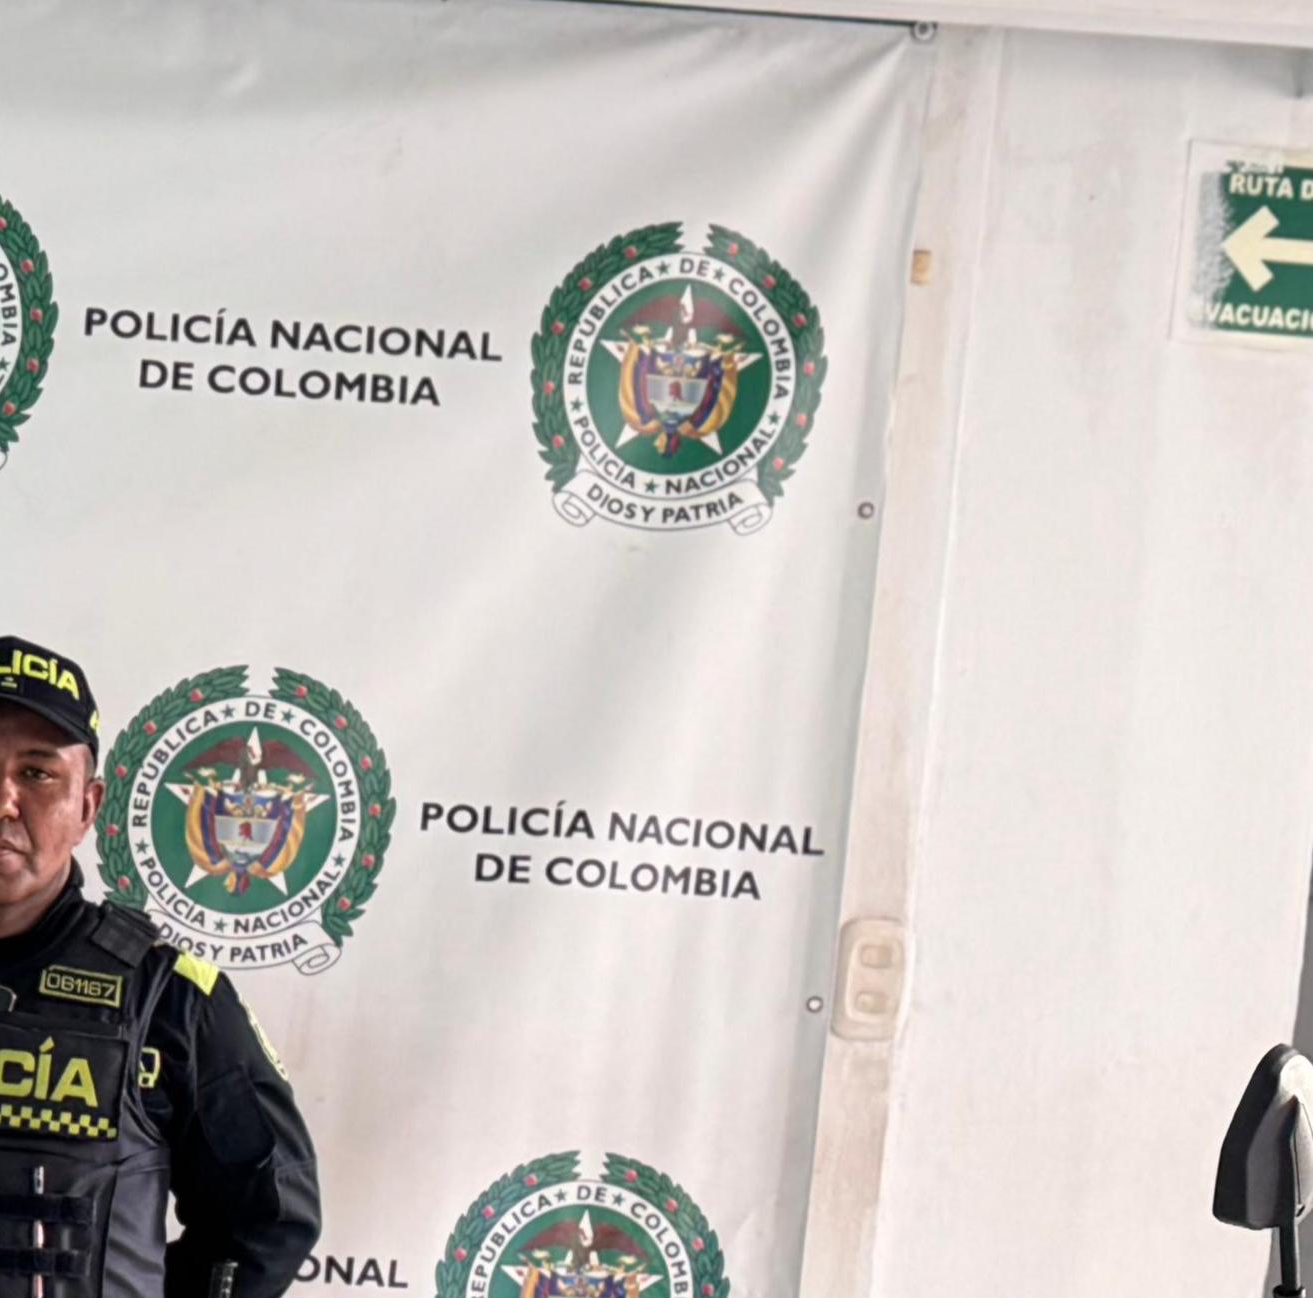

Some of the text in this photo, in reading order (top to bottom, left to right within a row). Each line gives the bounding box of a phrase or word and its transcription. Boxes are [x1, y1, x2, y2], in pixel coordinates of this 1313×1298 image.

[1229, 173, 1294, 199] RUTA
[85, 308, 501, 361] POLICÍA NACIONAL
[678, 258, 710, 278] DE
[731, 277, 786, 404] COLOMBIA
[140, 359, 439, 406] DE COLOMBIA
[662, 435, 767, 495] NACIONAL
[657, 497, 733, 525] PATRIA
[244, 702, 276, 721] DE
[298, 719, 358, 842] COLOMBIA
[421, 801, 825, 857] POLICÍA NACIONAL
[475, 854, 760, 900] DE COLOMBIA
[234, 872, 340, 933] NACIONAL
[230, 933, 308, 962] PATRIA
[577, 1187, 608, 1205] DE
